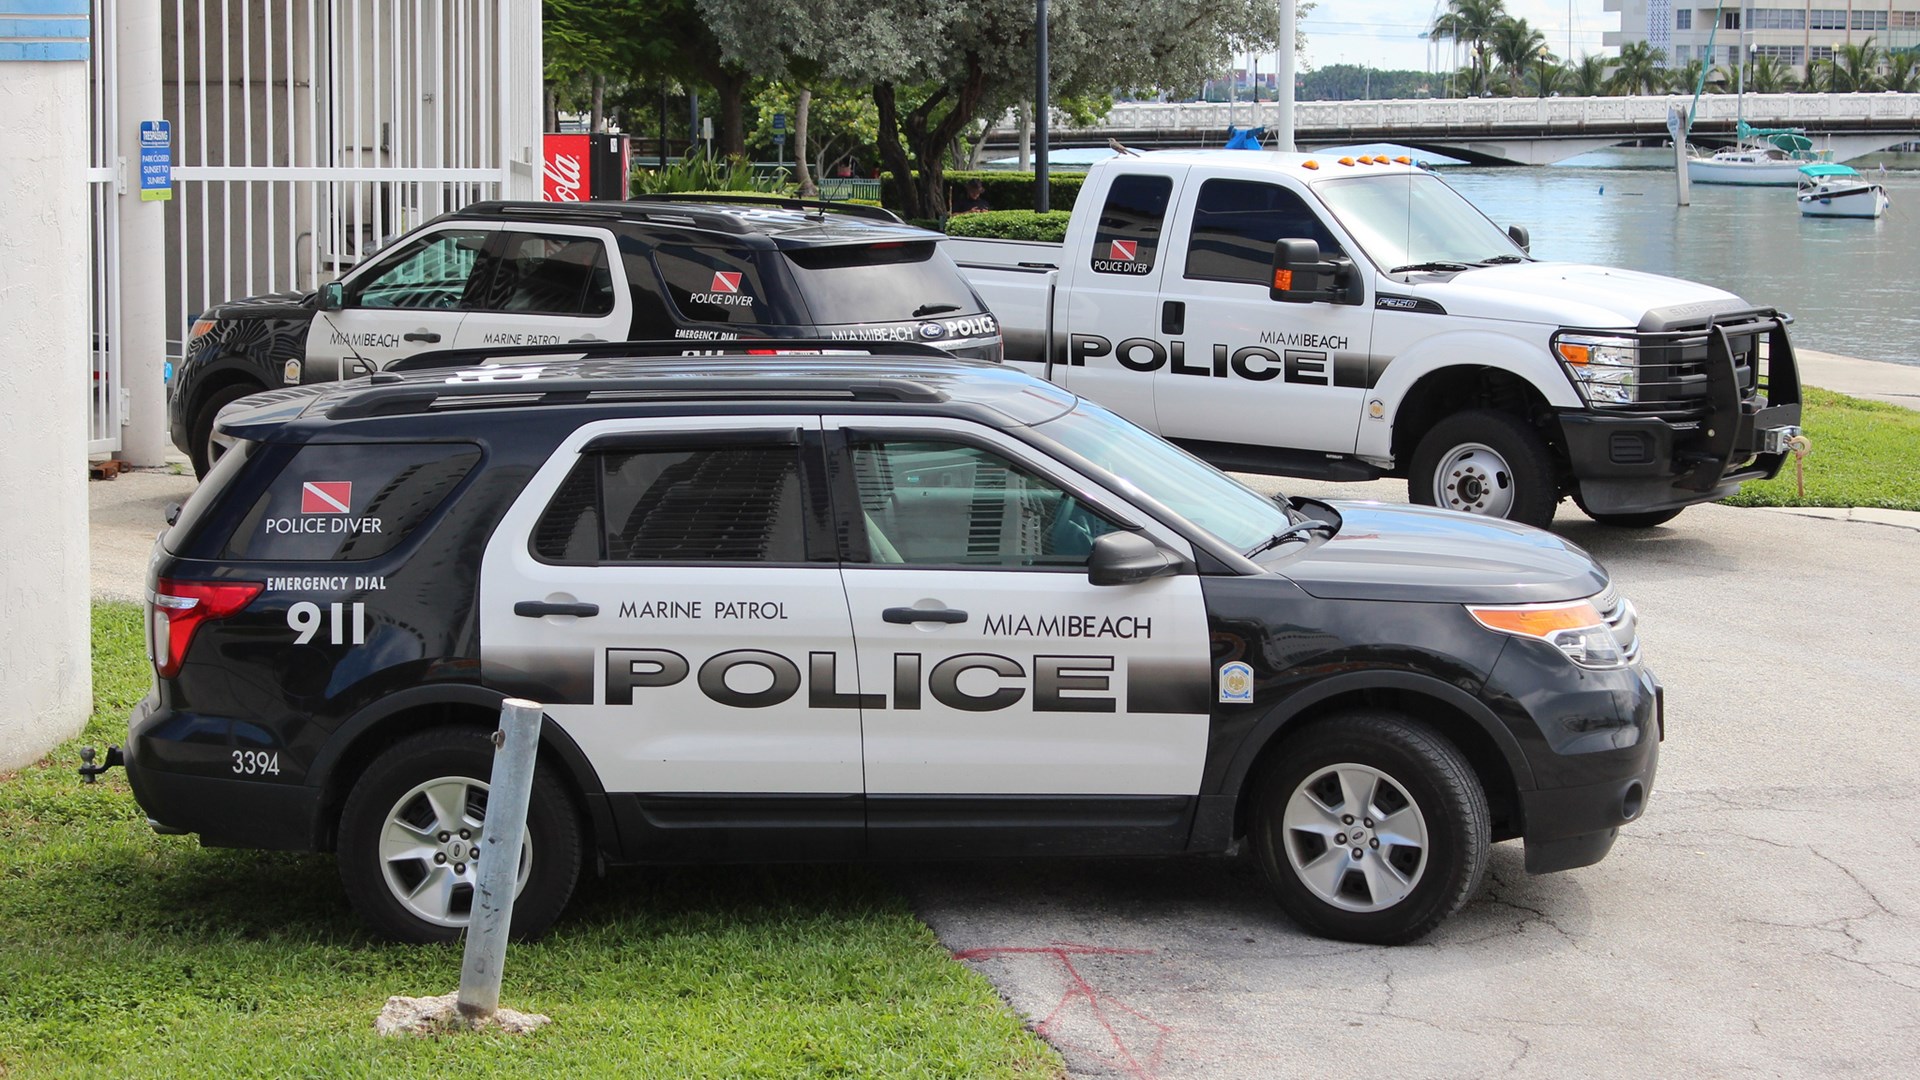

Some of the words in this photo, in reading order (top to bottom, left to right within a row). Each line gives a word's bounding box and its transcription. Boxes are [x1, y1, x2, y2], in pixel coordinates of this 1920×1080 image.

[142, 155, 153, 163] PARK
[153, 154, 170, 162] CLOSED
[143, 165, 161, 174] SUNSET
[162, 165, 169, 173] TO
[543, 153, 580, 201] ola
[147, 176, 166, 185] SUNRISE
[1094, 260, 1123, 271] POLICE
[1123, 262, 1148, 273] DIVER
[690, 293, 723, 304] POLICE
[724, 295, 753, 306] DIVER
[675, 329, 719, 340] EMERGENCY
[831, 326, 914, 341] MIAMIBEACH
[945, 316, 996, 337] POLICE
[330, 332, 400, 348] MIAMIBEACH
[483, 333, 522, 345] MARINE
[1259, 330, 1348, 350] MIAMIBEACH
[1070, 333, 1329, 386] POLICE
[265, 518, 326, 534] POLICE
[331, 518, 382, 534] DIVER
[266, 577, 348, 591] EMERGENCY
[354, 577, 386, 590] DIAL
[618, 601, 702, 619] MARINE
[714, 601, 788, 620] PATROL
[286, 601, 365, 645] 911
[983, 613, 1152, 639] MIAMIBEACH
[605, 647, 1117, 713] POLICE
[231, 750, 280, 776] 3394
